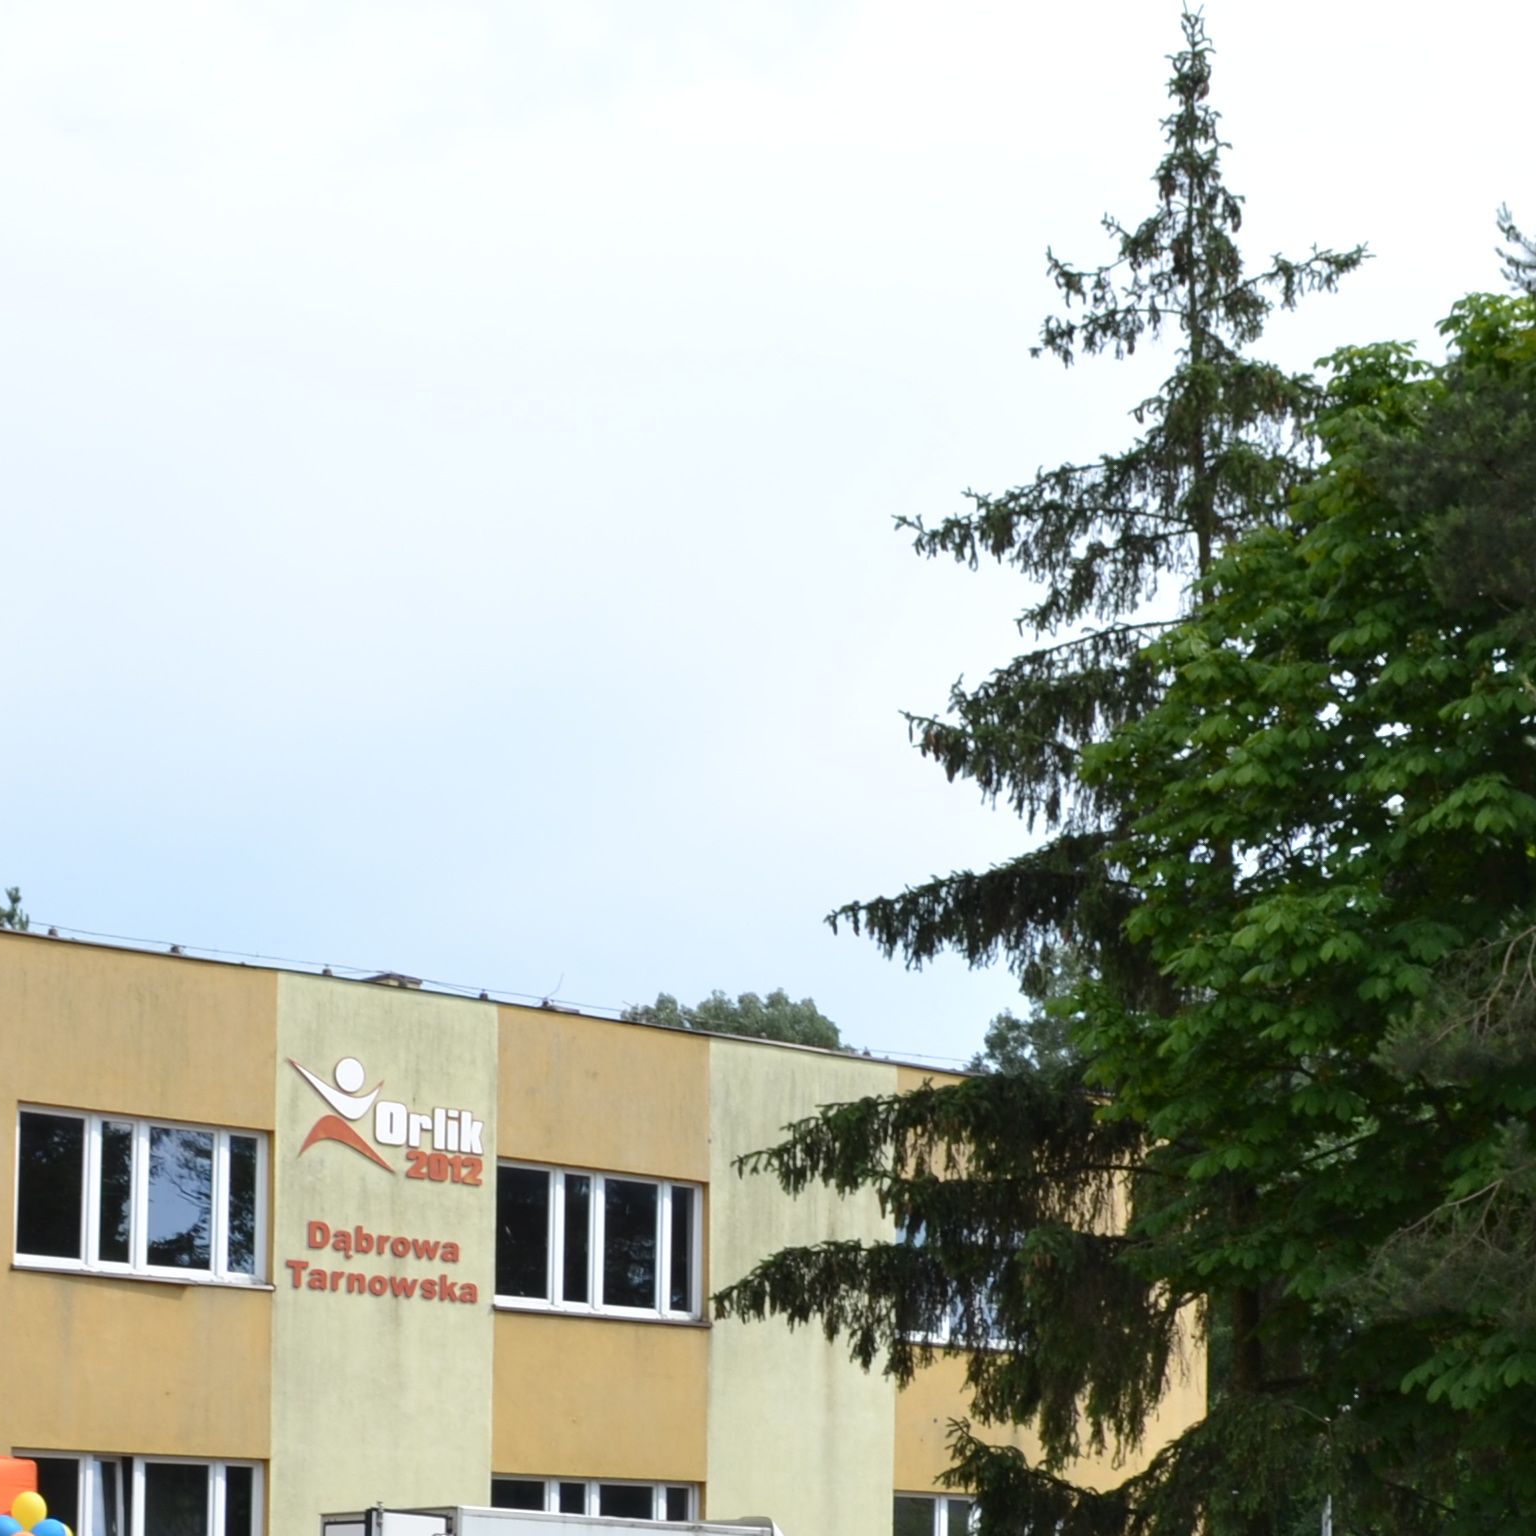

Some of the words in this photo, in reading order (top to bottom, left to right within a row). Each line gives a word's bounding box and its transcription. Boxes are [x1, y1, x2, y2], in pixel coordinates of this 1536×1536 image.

[375, 1100, 484, 1155] Orlik
[406, 1150, 483, 1186] 2012
[308, 1221, 460, 1262] Dąbrowa
[286, 1260, 478, 1303] Tarnowska
